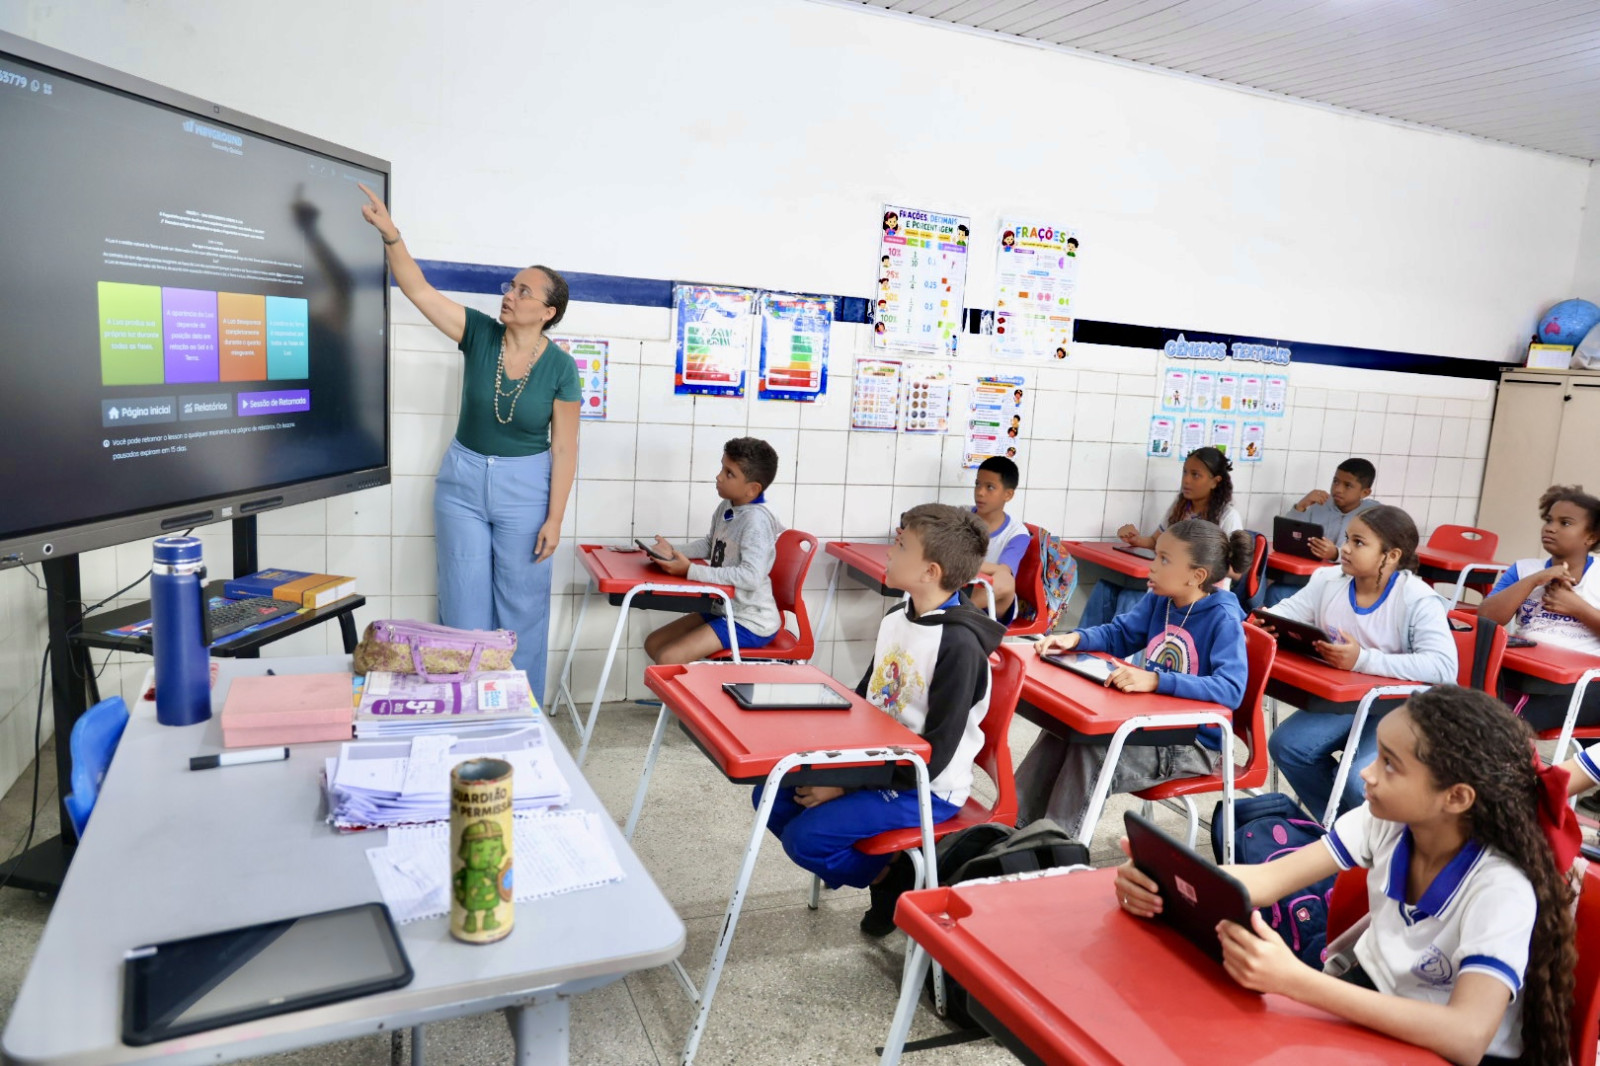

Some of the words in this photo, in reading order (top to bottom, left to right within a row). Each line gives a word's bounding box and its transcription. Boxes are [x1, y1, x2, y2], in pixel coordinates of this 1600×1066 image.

[900, 210, 928, 221] FRAÇÕES
[1015, 226, 1066, 243] FRAÇÕES
[1164, 333, 1226, 360] GÊNEROS
[1231, 342, 1291, 366] TEXTUAIS
[194, 402, 228, 413] Relatórios
[249, 399, 270, 408] Sessão
[270, 397, 278, 406] de
[121, 406, 148, 419] Página
[149, 404, 171, 416] Inicial
[112, 437, 126, 446] Você
[126, 436, 141, 446] pode
[112, 450, 140, 460] pausados
[140, 448, 160, 457] expiram
[453, 787, 507, 804] GUARDIÃO
[460, 797, 512, 818] PERMISSÃ
